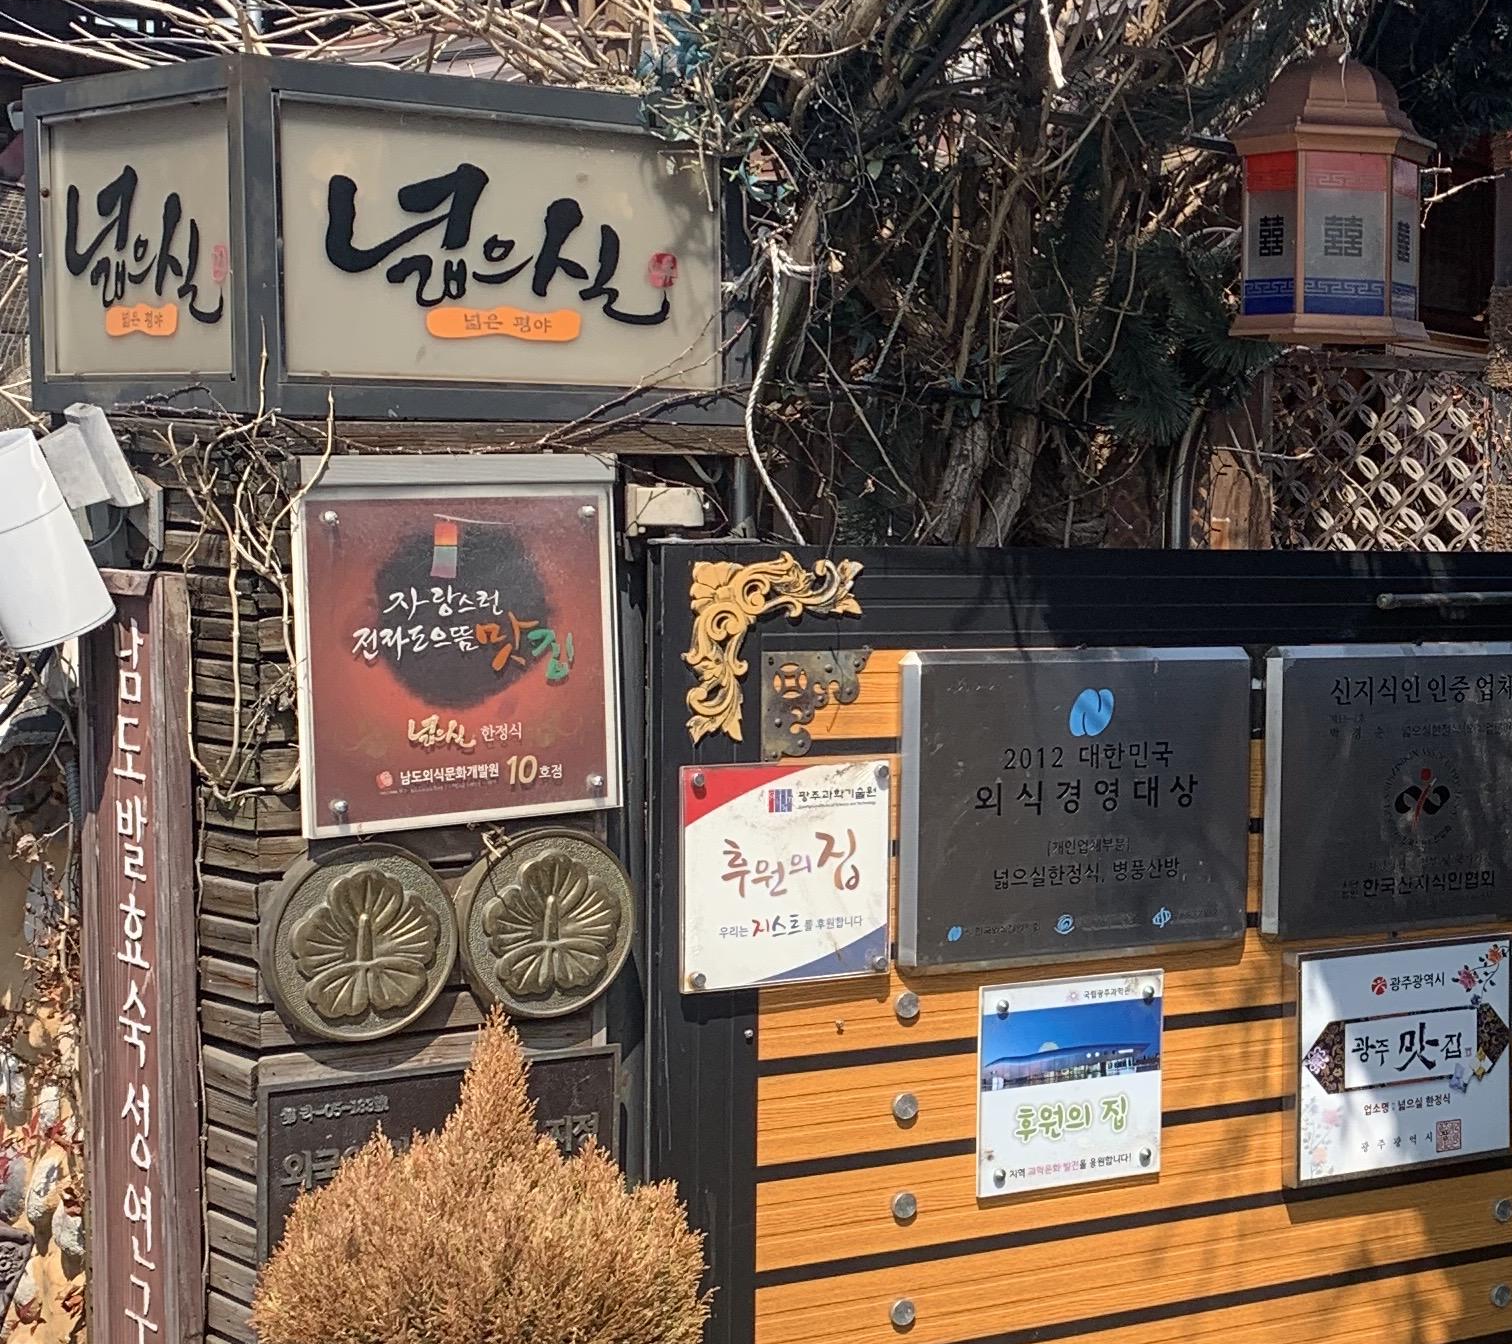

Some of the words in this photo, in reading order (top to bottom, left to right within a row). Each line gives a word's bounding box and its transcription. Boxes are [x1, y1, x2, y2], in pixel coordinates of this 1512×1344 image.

[463, 310, 504, 333] 넓은
[511, 312, 554, 336] 평야
[382, 584, 504, 621] 자랑스런
[1330, 674, 1421, 706] 신지식인
[479, 721, 523, 744] 한정식
[1003, 746, 1064, 771] 2012
[1078, 741, 1174, 770] 대한민국
[399, 762, 500, 786] 남도외식문화개발원
[797, 786, 878, 803] 광주과학기술원
[974, 773, 1199, 817] 외식경영대상
[1112, 856, 1180, 882] 병풍산방
[718, 925, 749, 939] 우리는
[815, 914, 863, 931] 후원합니다
[1389, 971, 1446, 992] 광주광역시
[1351, 1036, 1390, 1067] 광주
[1396, 1021, 1463, 1073] 맛집
[1363, 1101, 1390, 1116] 업소명
[1425, 1092, 1451, 1108] 한정식
[1015, 1102, 1092, 1143] 후원의
[1100, 1094, 1129, 1133] 집
